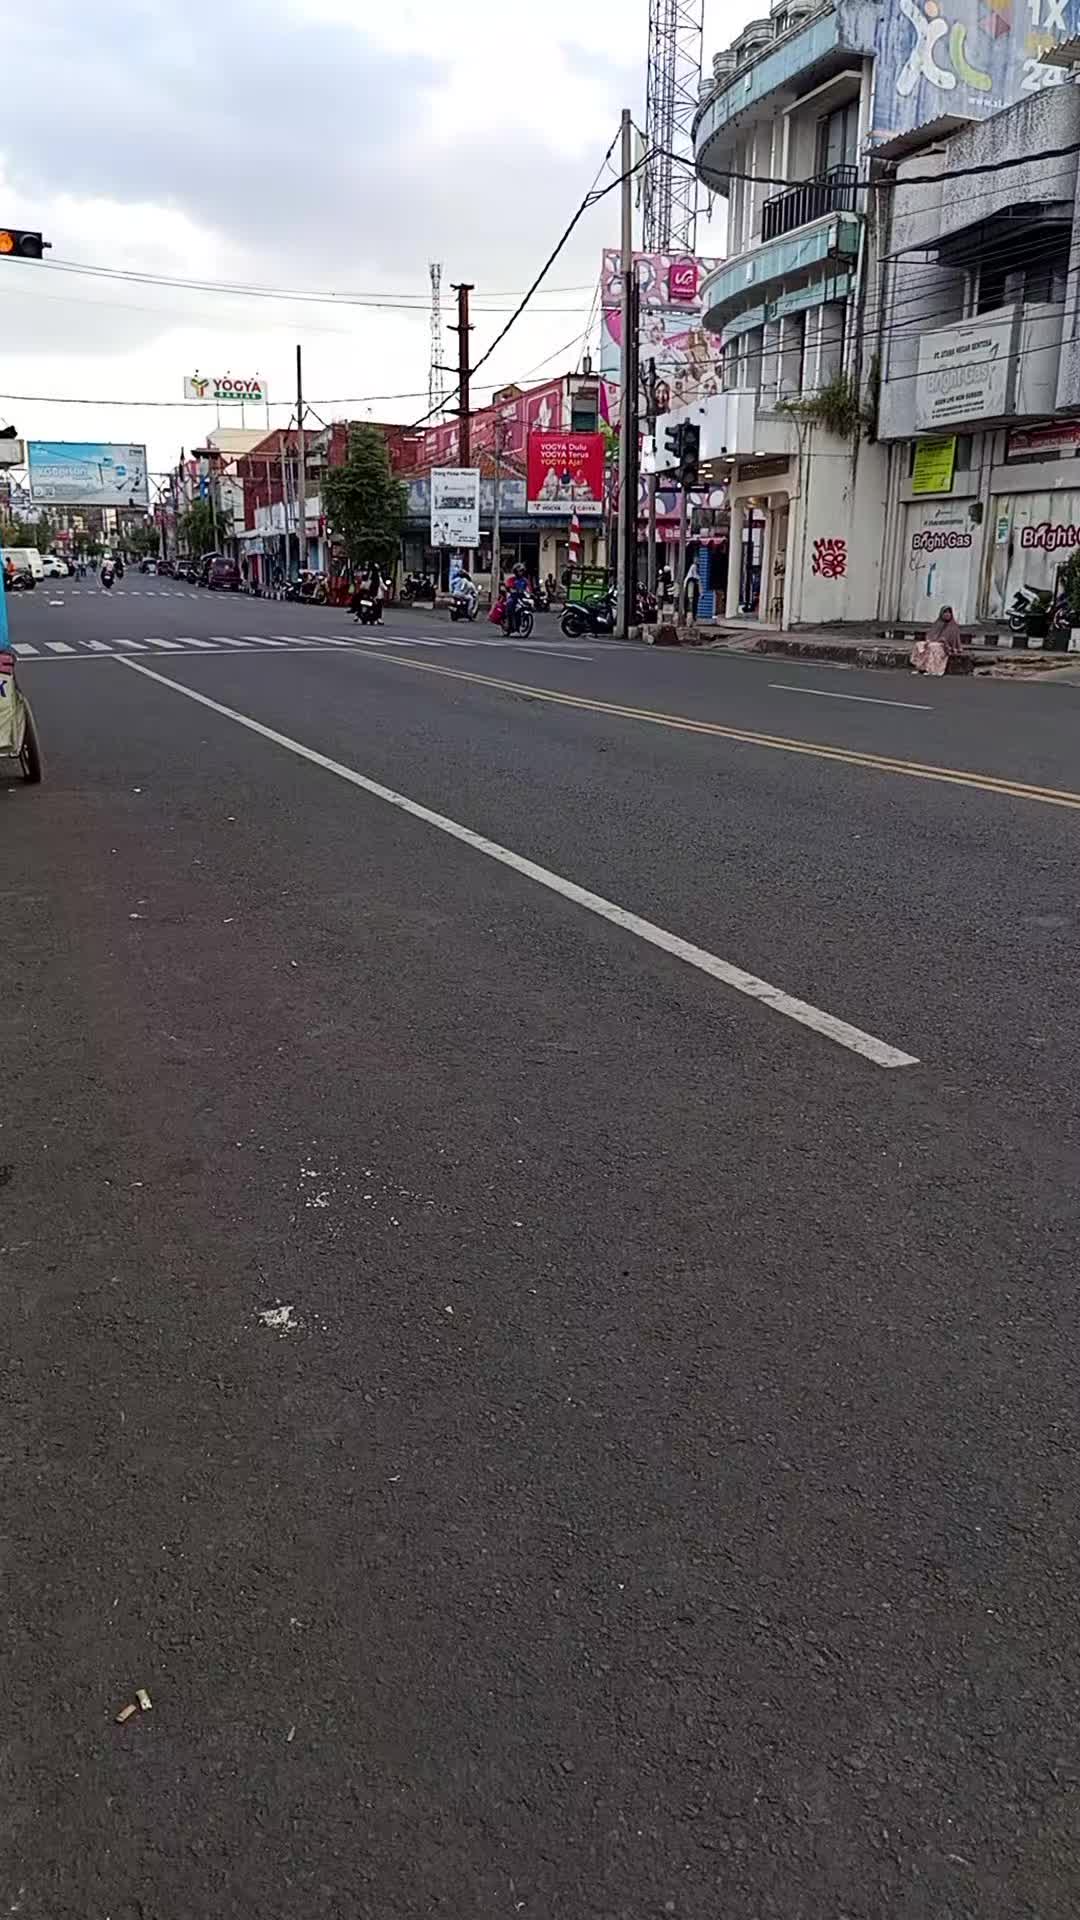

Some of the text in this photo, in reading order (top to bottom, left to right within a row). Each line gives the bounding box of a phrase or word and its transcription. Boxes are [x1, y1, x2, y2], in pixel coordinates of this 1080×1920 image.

[213, 379, 262, 392] YOGYA
[541, 443, 587, 451] YOGYA Dulu
[569, 451, 589, 459] Terus
[912, 531, 971, 551] Bright Gas
[1021, 523, 1076, 551] Bright
